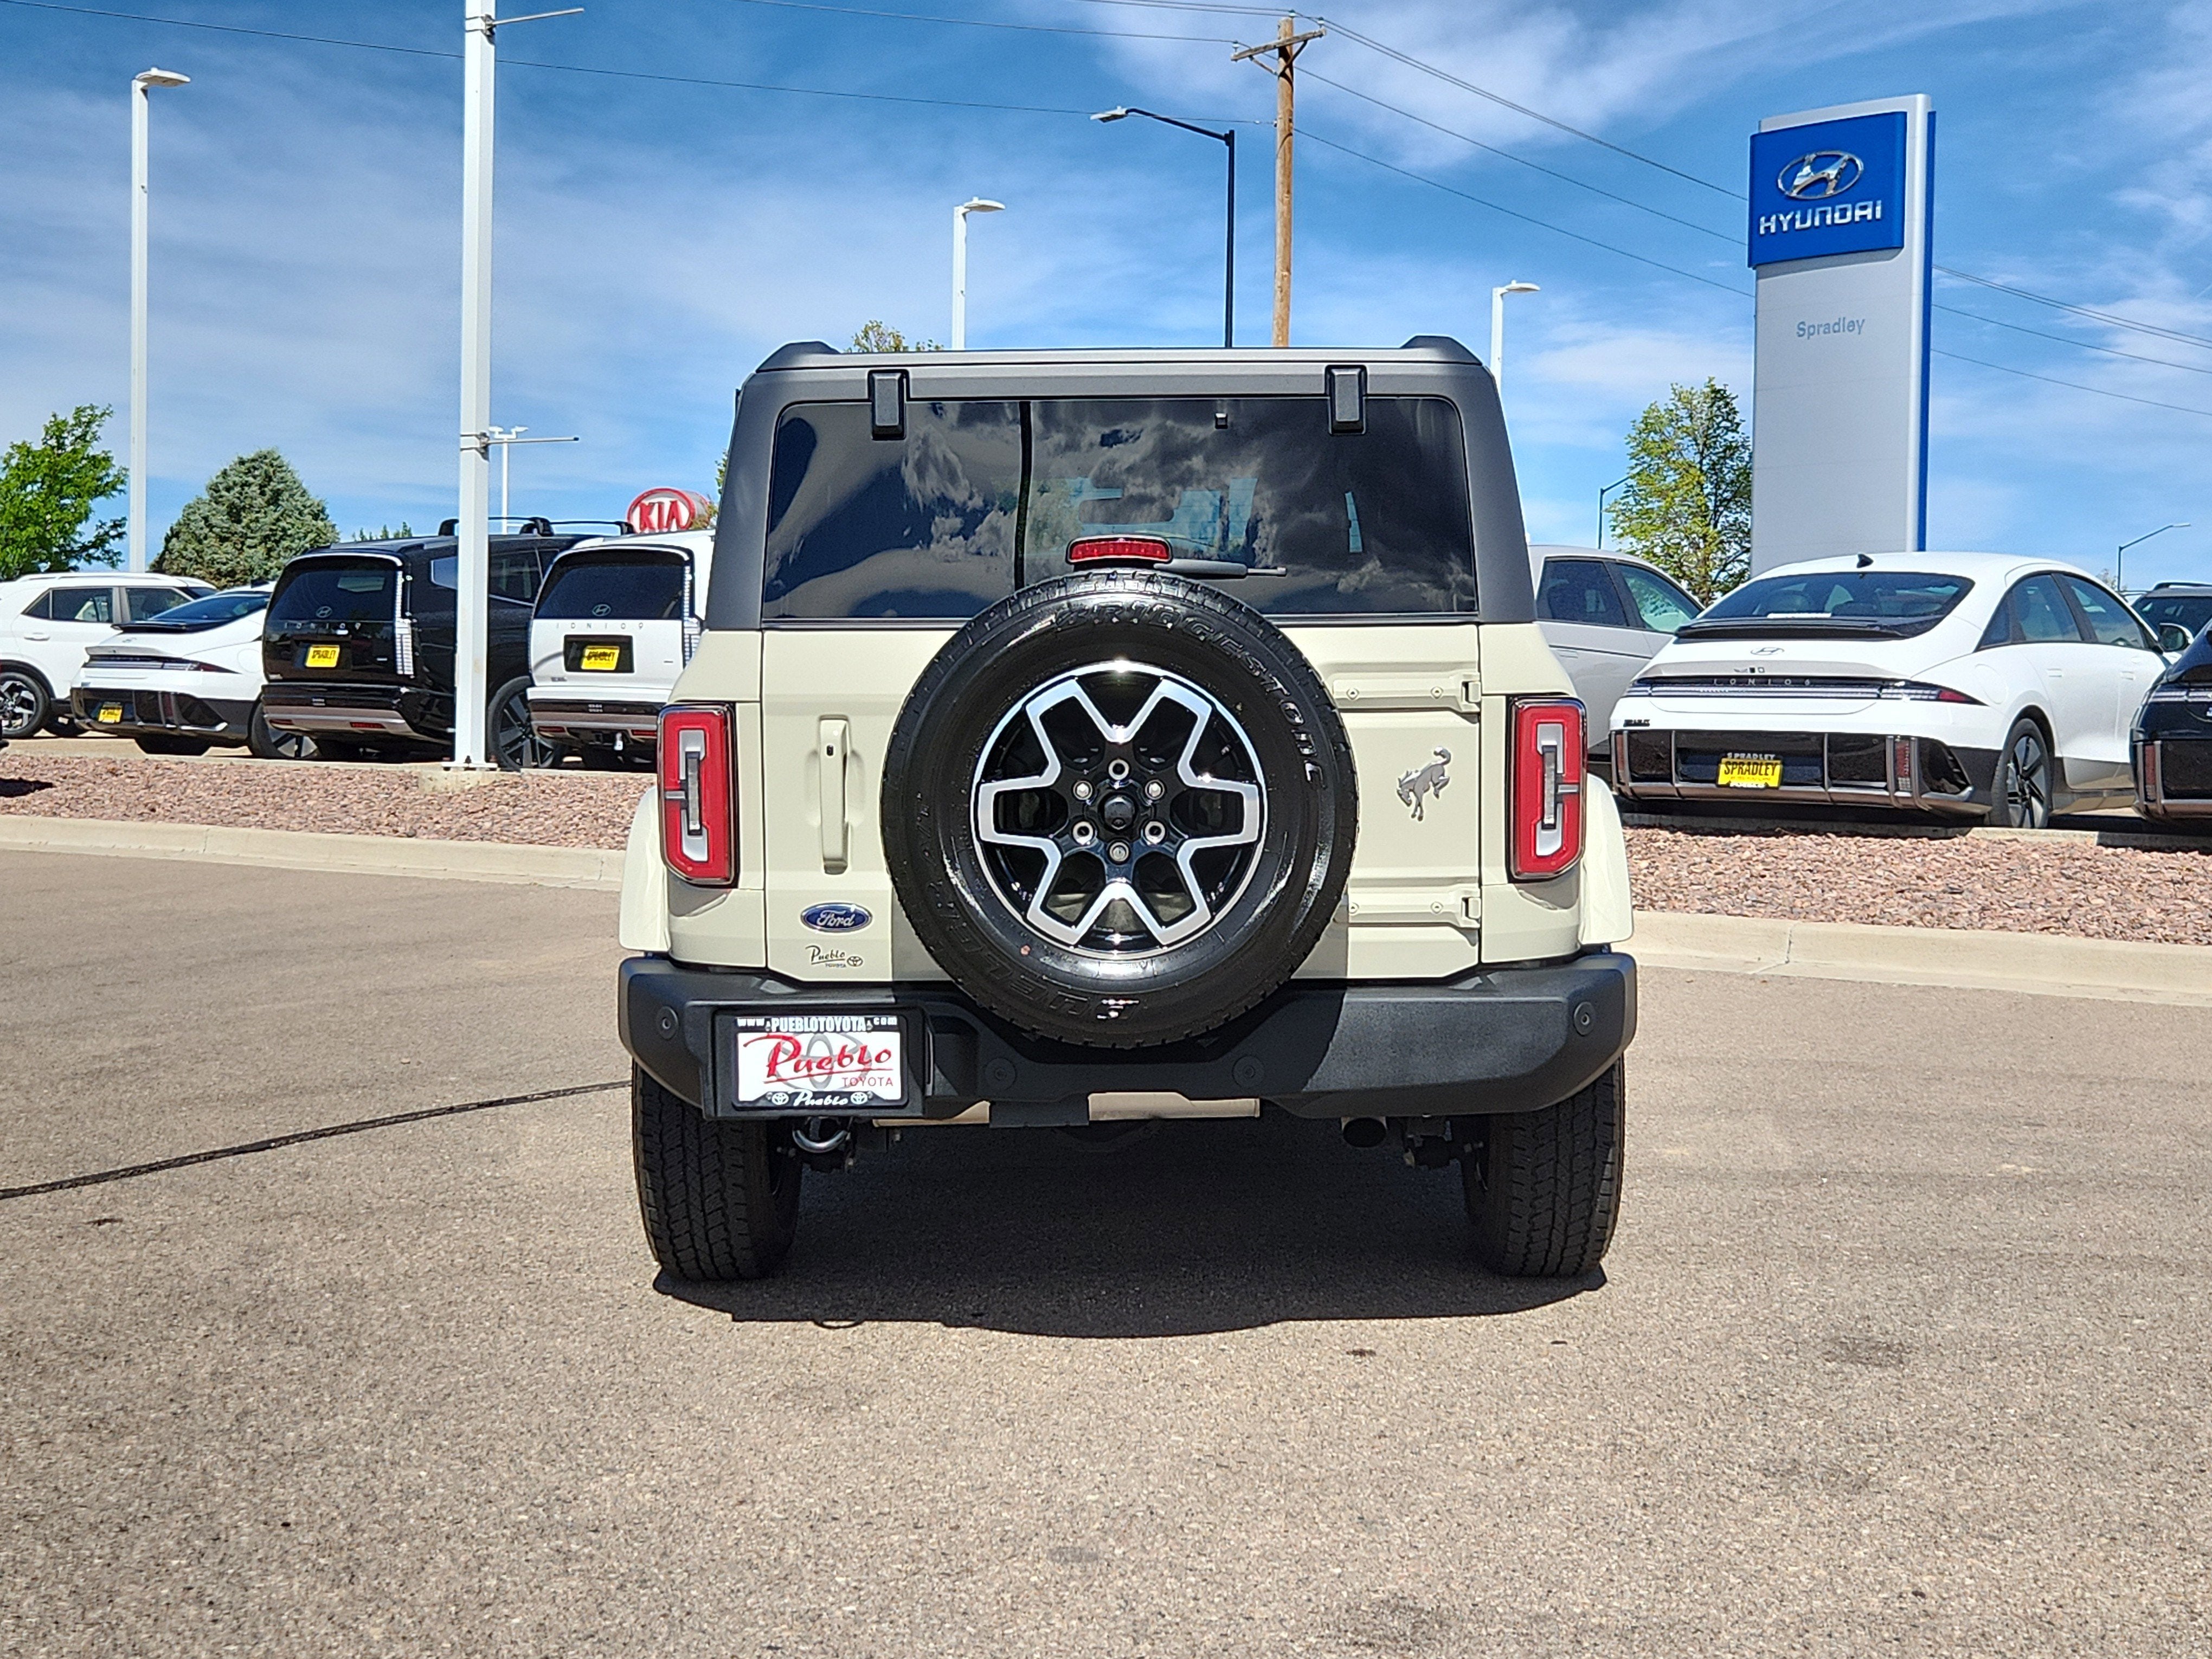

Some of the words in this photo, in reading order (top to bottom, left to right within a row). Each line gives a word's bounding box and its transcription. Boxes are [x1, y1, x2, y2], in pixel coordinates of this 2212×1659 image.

[1759, 200, 1882, 235] HYUNDAI
[1796, 317, 1866, 340] Spradley
[639, 499, 684, 530] KIA
[1053, 600, 1326, 790] BRIDGESTONE
[1724, 761, 1778, 776] SPRADLEY
[816, 910, 856, 927] Ford
[805, 945, 845, 962] Pueblo
[743, 1032, 892, 1078] Pueblo
[842, 1077, 893, 1087] TOYOTA
[788, 1089, 848, 1107] Pueblo
